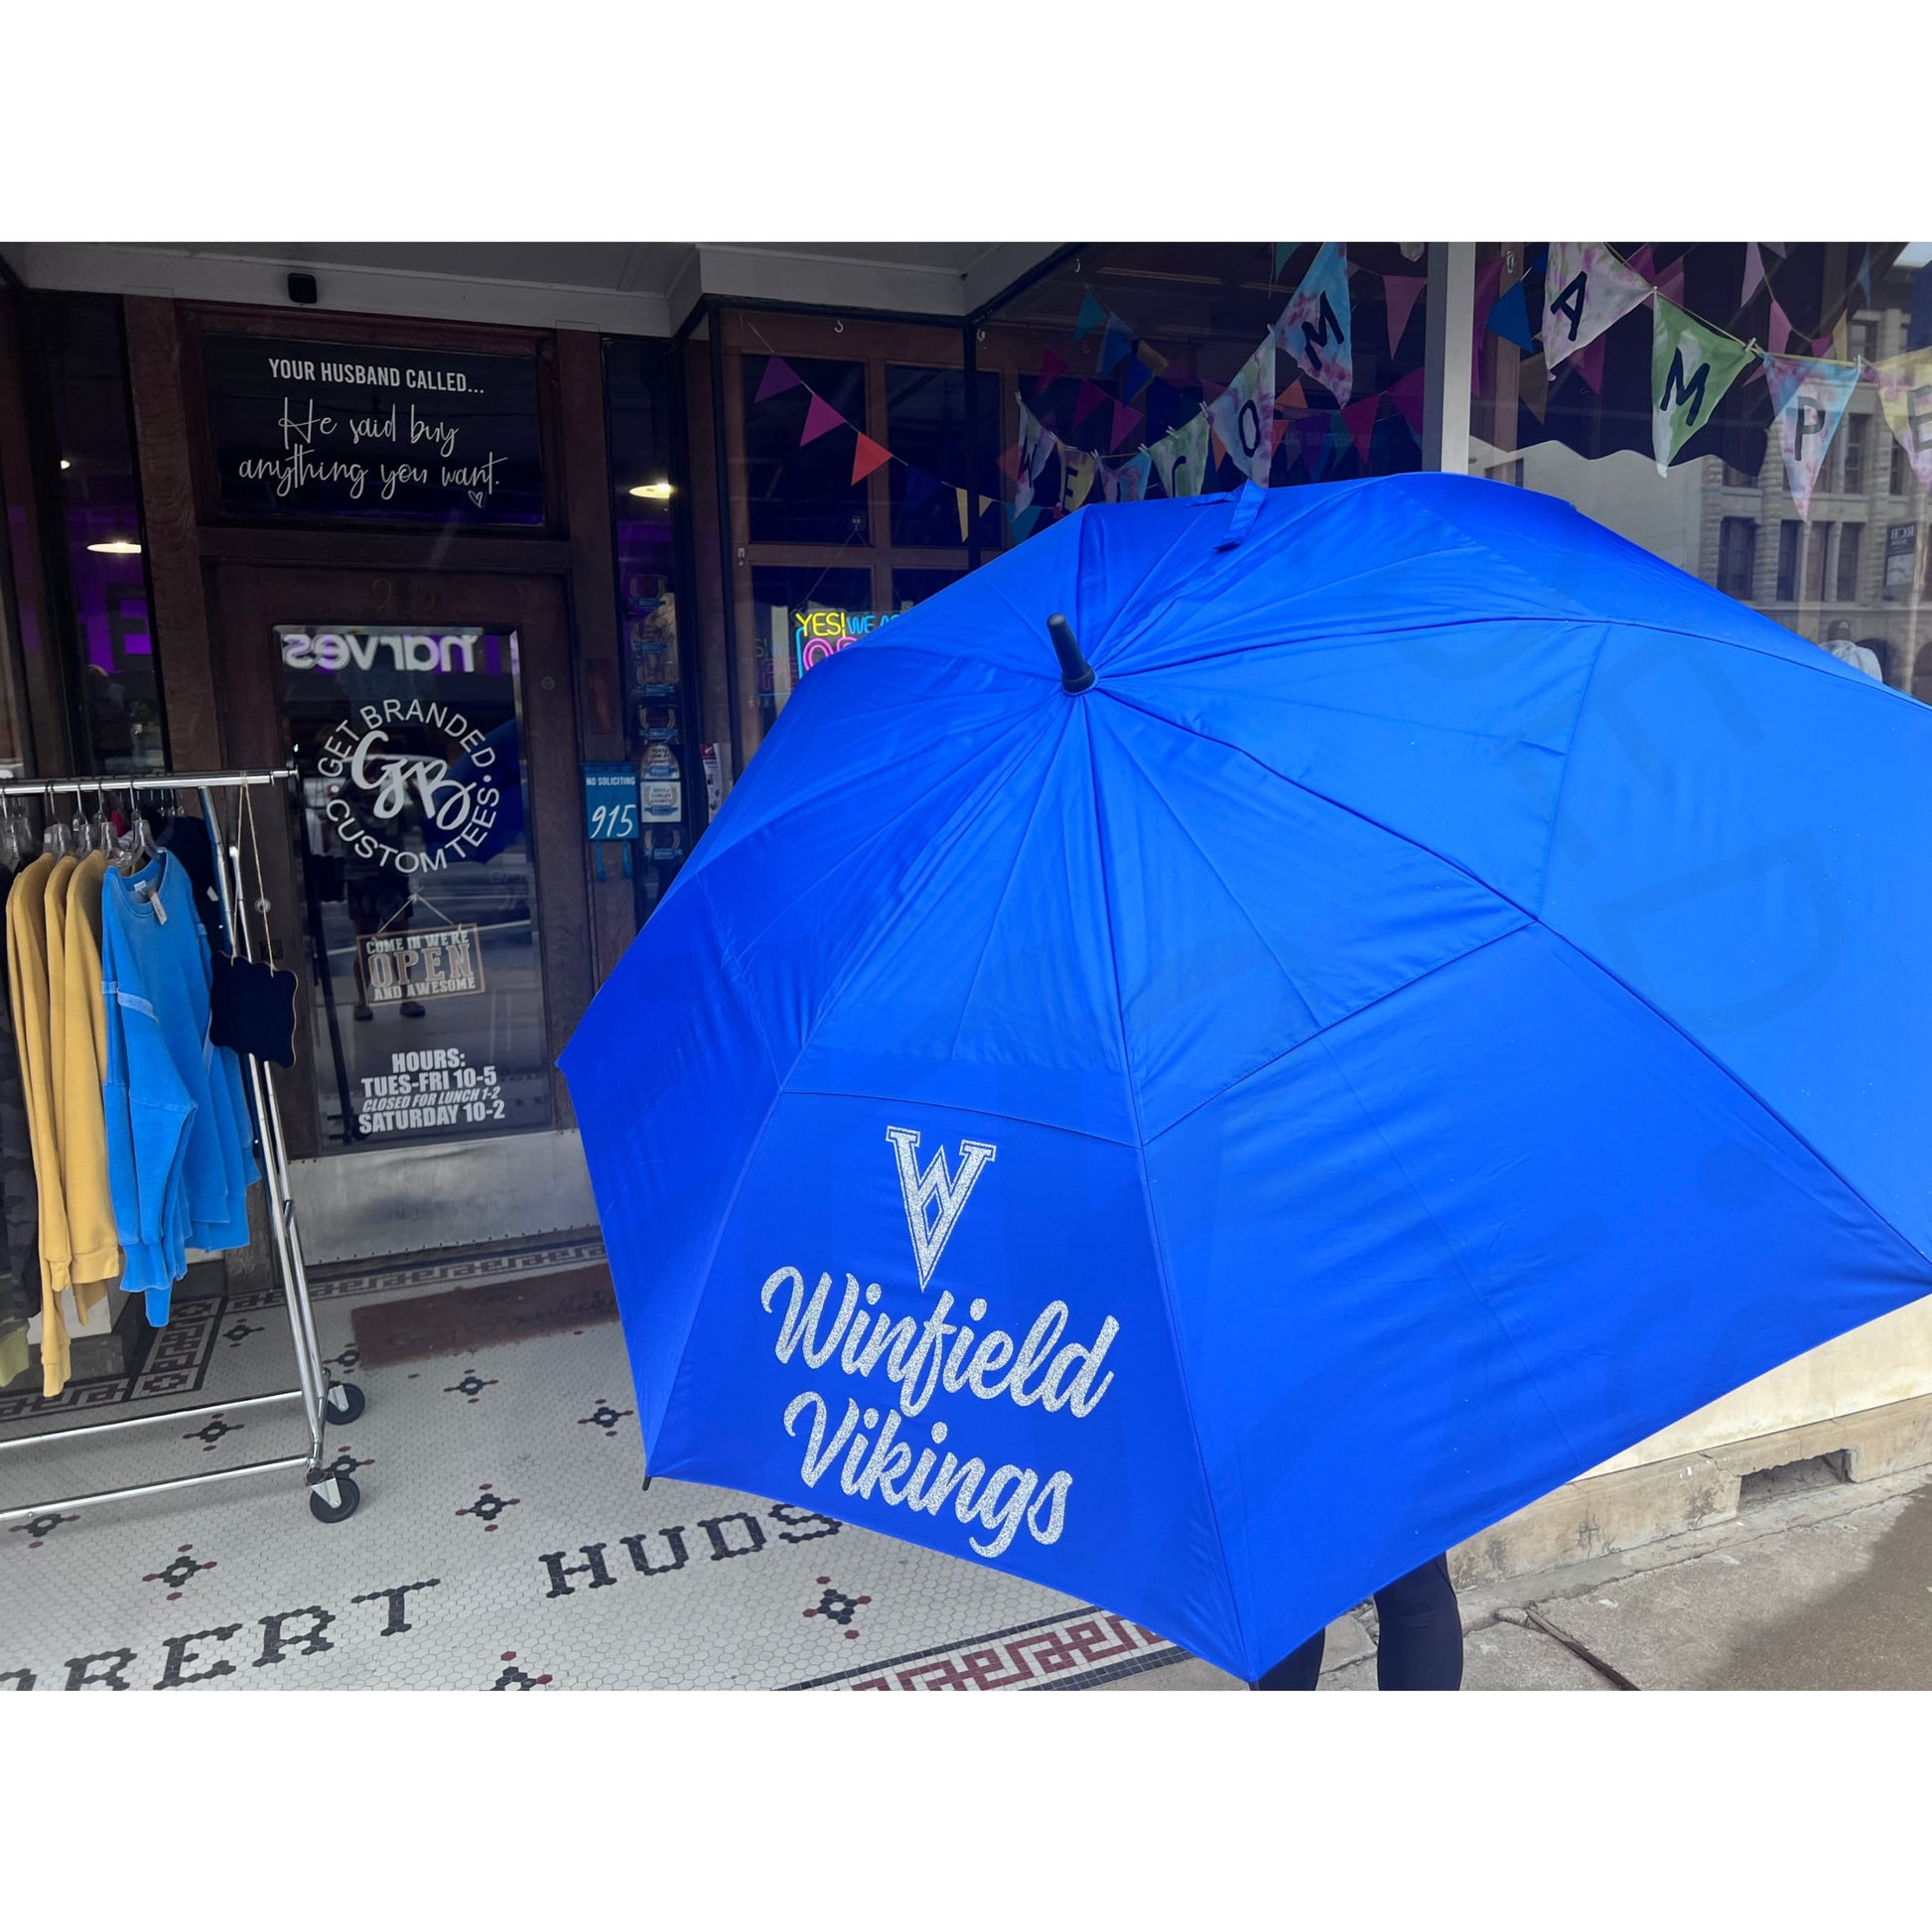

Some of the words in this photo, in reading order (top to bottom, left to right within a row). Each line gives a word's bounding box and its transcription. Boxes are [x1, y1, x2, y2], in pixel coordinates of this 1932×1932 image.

[268, 358, 316, 381] YOUR
[321, 361, 401, 387] HUSBAND
[406, 368, 484, 394] CALLED...
[277, 396, 338, 450] He
[349, 403, 396, 444] said
[410, 403, 459, 457] buy
[238, 443, 368, 499] anything
[380, 463, 428, 500] you
[441, 451, 508, 494] want.
[795, 612, 846, 637] YES!
[846, 615, 877, 634] WE
[318, 719, 360, 777] GET
[359, 698, 496, 768] BRANDED
[586, 777, 597, 786] NO
[598, 776, 636, 786] SOLICITING
[325, 798, 448, 874] CUSTOM
[444, 787, 499, 859] TEES
[589, 804, 636, 839] 915
[366, 938, 405, 955] COME
[407, 934, 421, 950] IN
[367, 943, 474, 989] OPEN
[373, 986, 403, 1002] AND
[406, 976, 477, 998] AWESOME
[391, 1047, 467, 1074] HOURS:
[360, 1070, 450, 1098] TUES-FRI
[454, 1065, 497, 1089] 10-5
[362, 1095, 411, 1113] CLOSED
[412, 1093, 438, 1109] FOR
[438, 1088, 481, 1106] LUNCH
[483, 1086, 501, 1100] 1-2
[358, 1103, 460, 1135] SATURDAY
[463, 1099, 506, 1122] 10-2
[760, 1266, 1120, 1418] Winfield
[783, 1391, 1073, 1558] Vikings
